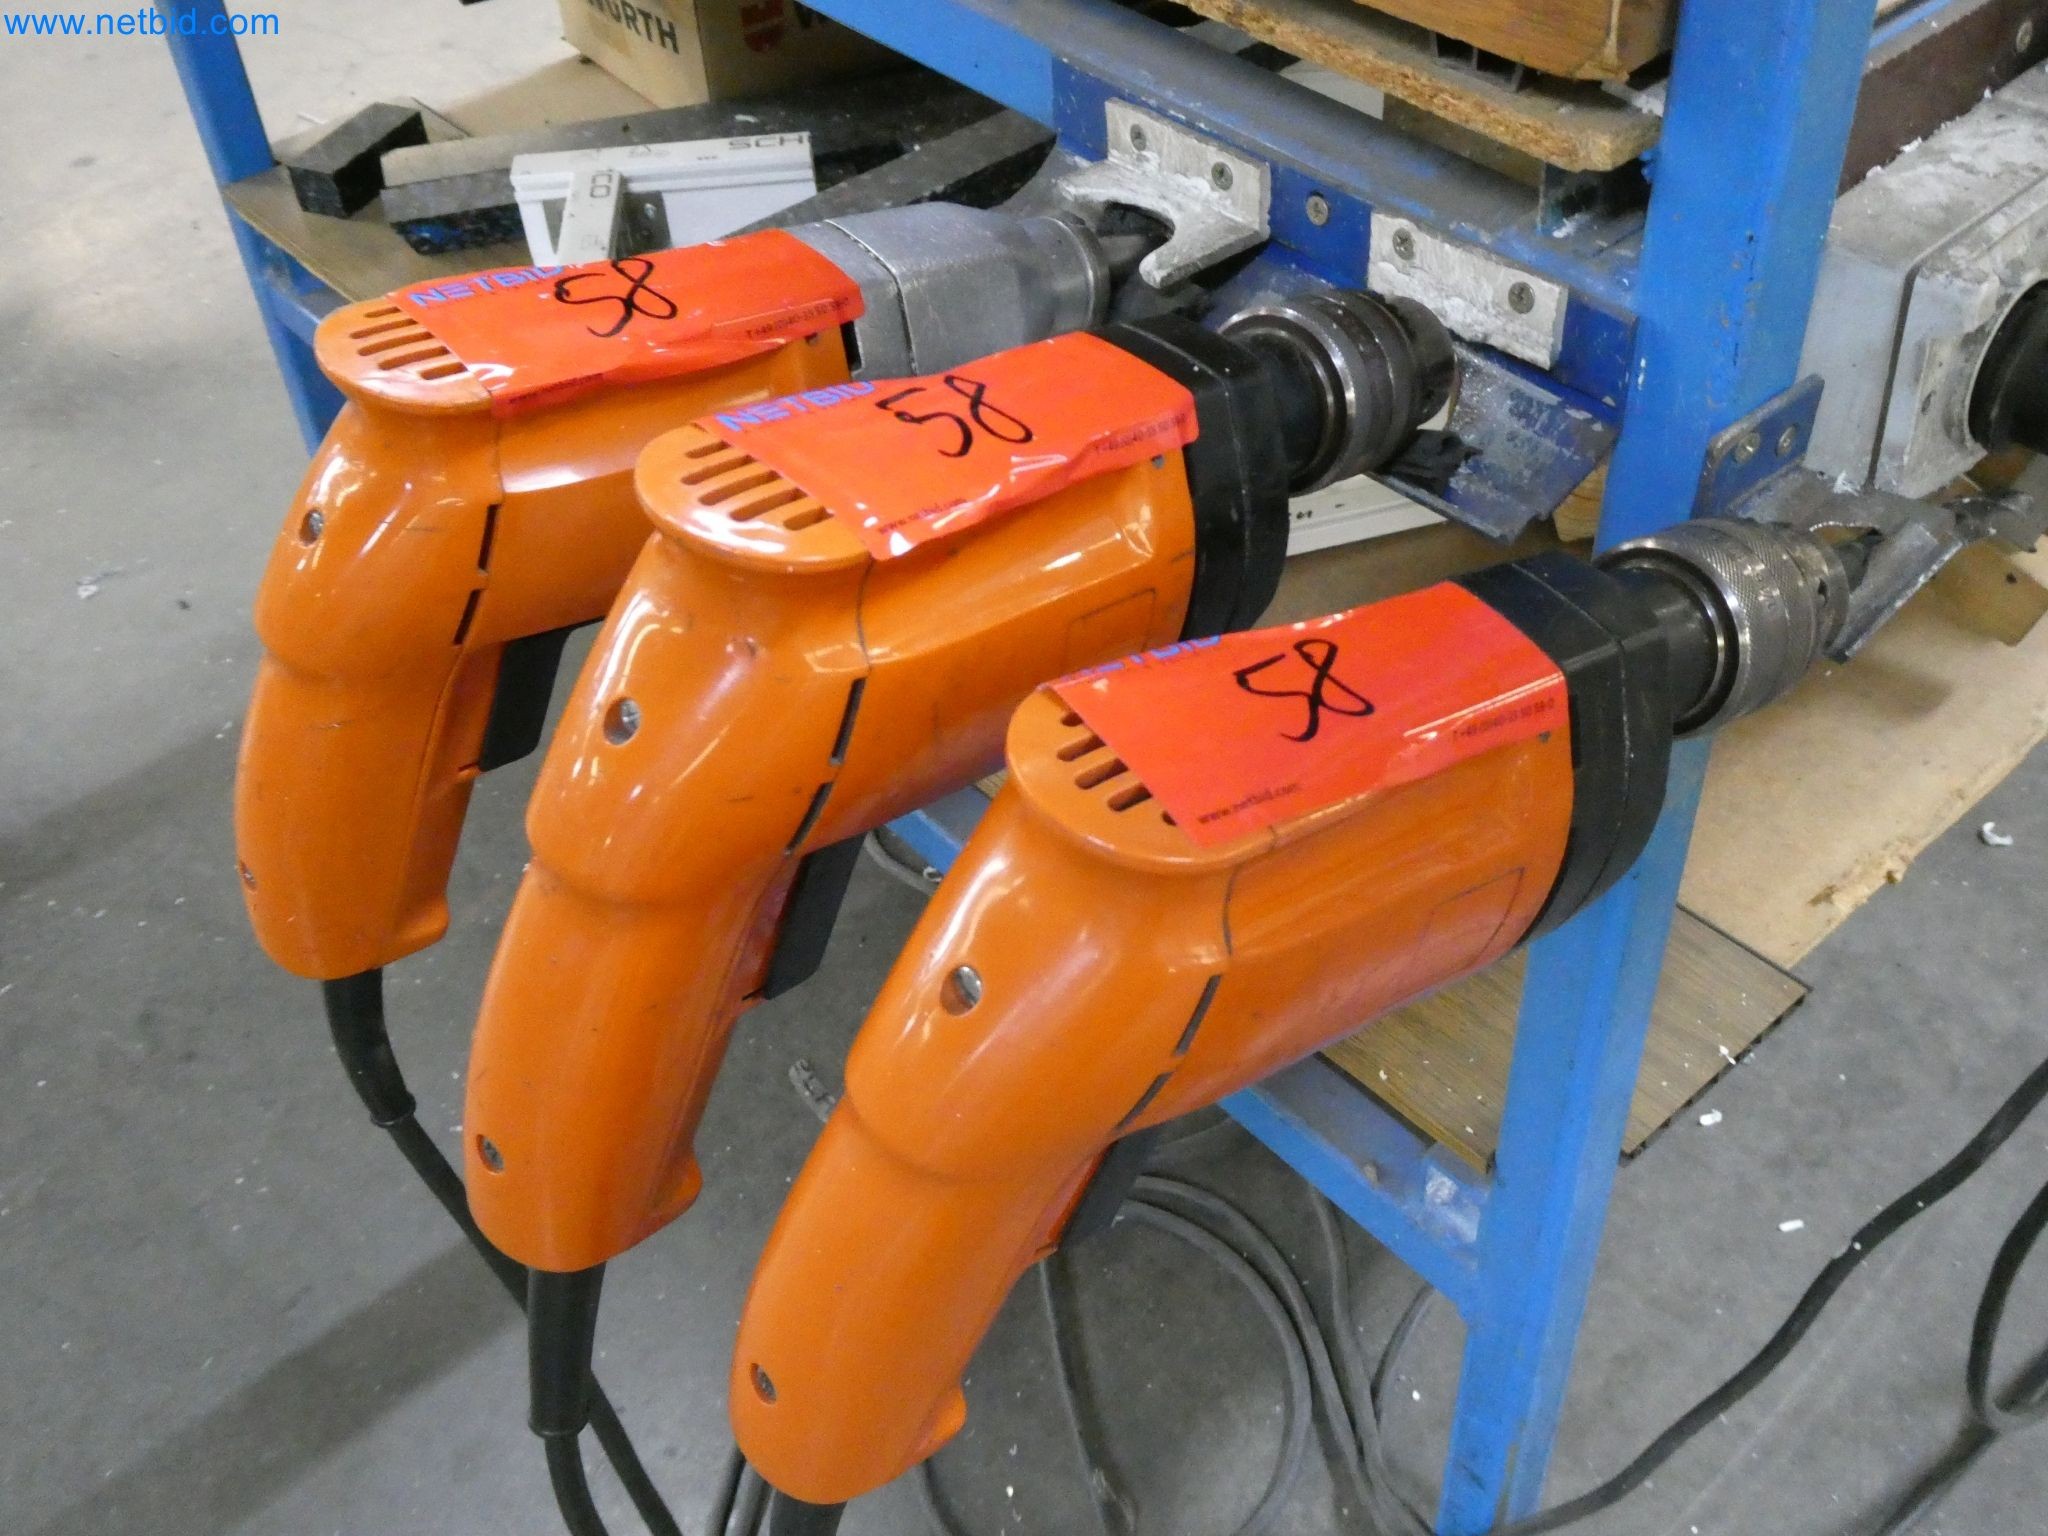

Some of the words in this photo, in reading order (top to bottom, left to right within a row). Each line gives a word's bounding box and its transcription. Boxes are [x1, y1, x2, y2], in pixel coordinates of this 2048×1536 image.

[408, 265, 564, 308] NETBID
[554, 257, 678, 338] 58
[874, 374, 1033, 458] 58
[1232, 638, 1375, 742] 58
